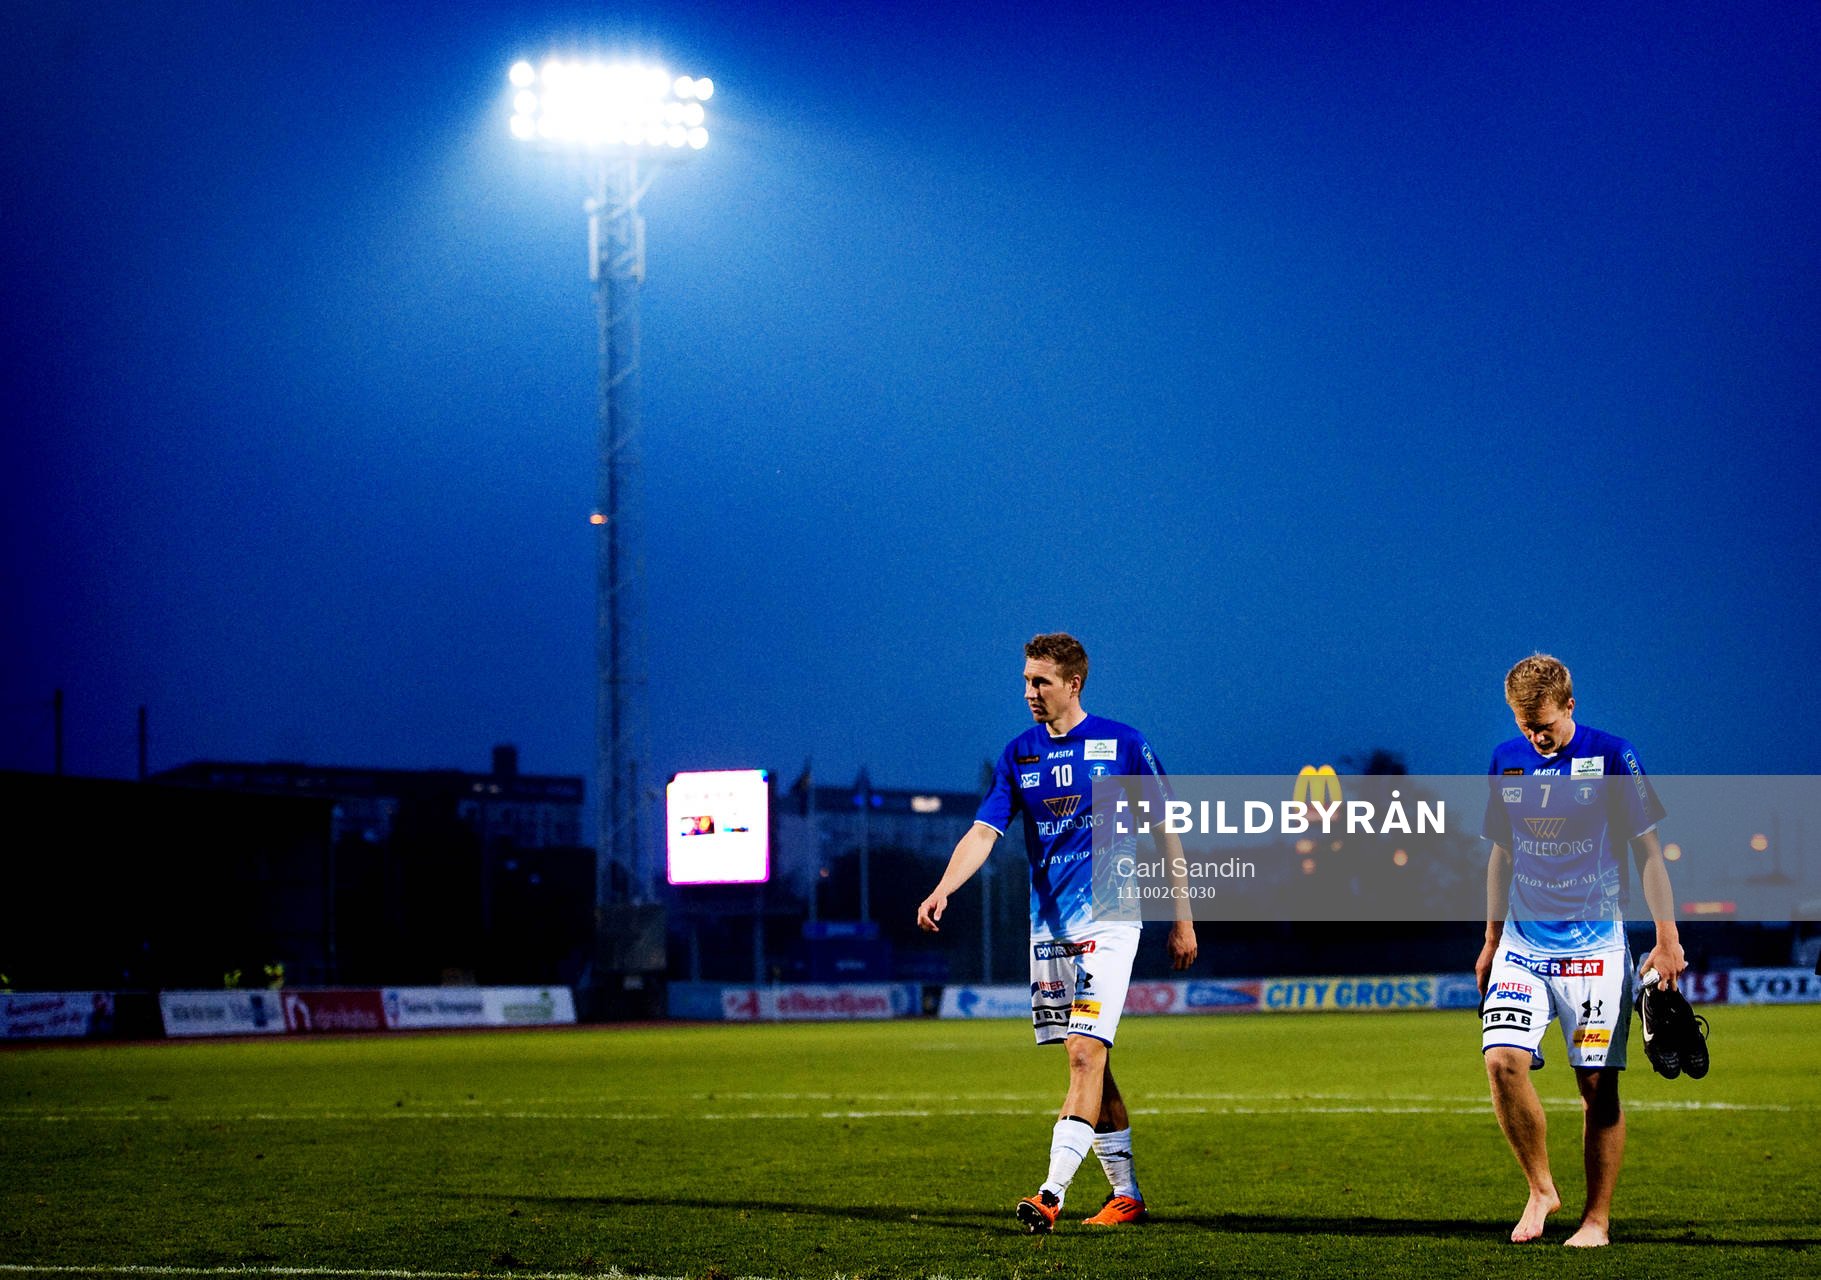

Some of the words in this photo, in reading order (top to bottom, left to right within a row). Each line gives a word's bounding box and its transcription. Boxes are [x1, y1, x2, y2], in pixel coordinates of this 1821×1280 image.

[1047, 750, 1074, 760] MASITA
[1051, 764, 1073, 788] 10
[1540, 784, 1551, 808] 7
[1565, 962, 1601, 974] HEAT
[1039, 980, 1065, 991] INTER
[1498, 982, 1533, 994] INTER
[1041, 989, 1066, 1000] SPORT
[1265, 982, 1329, 1008] CITY
[1335, 980, 1435, 1008] GROSS
[1496, 991, 1532, 1003] SPORT
